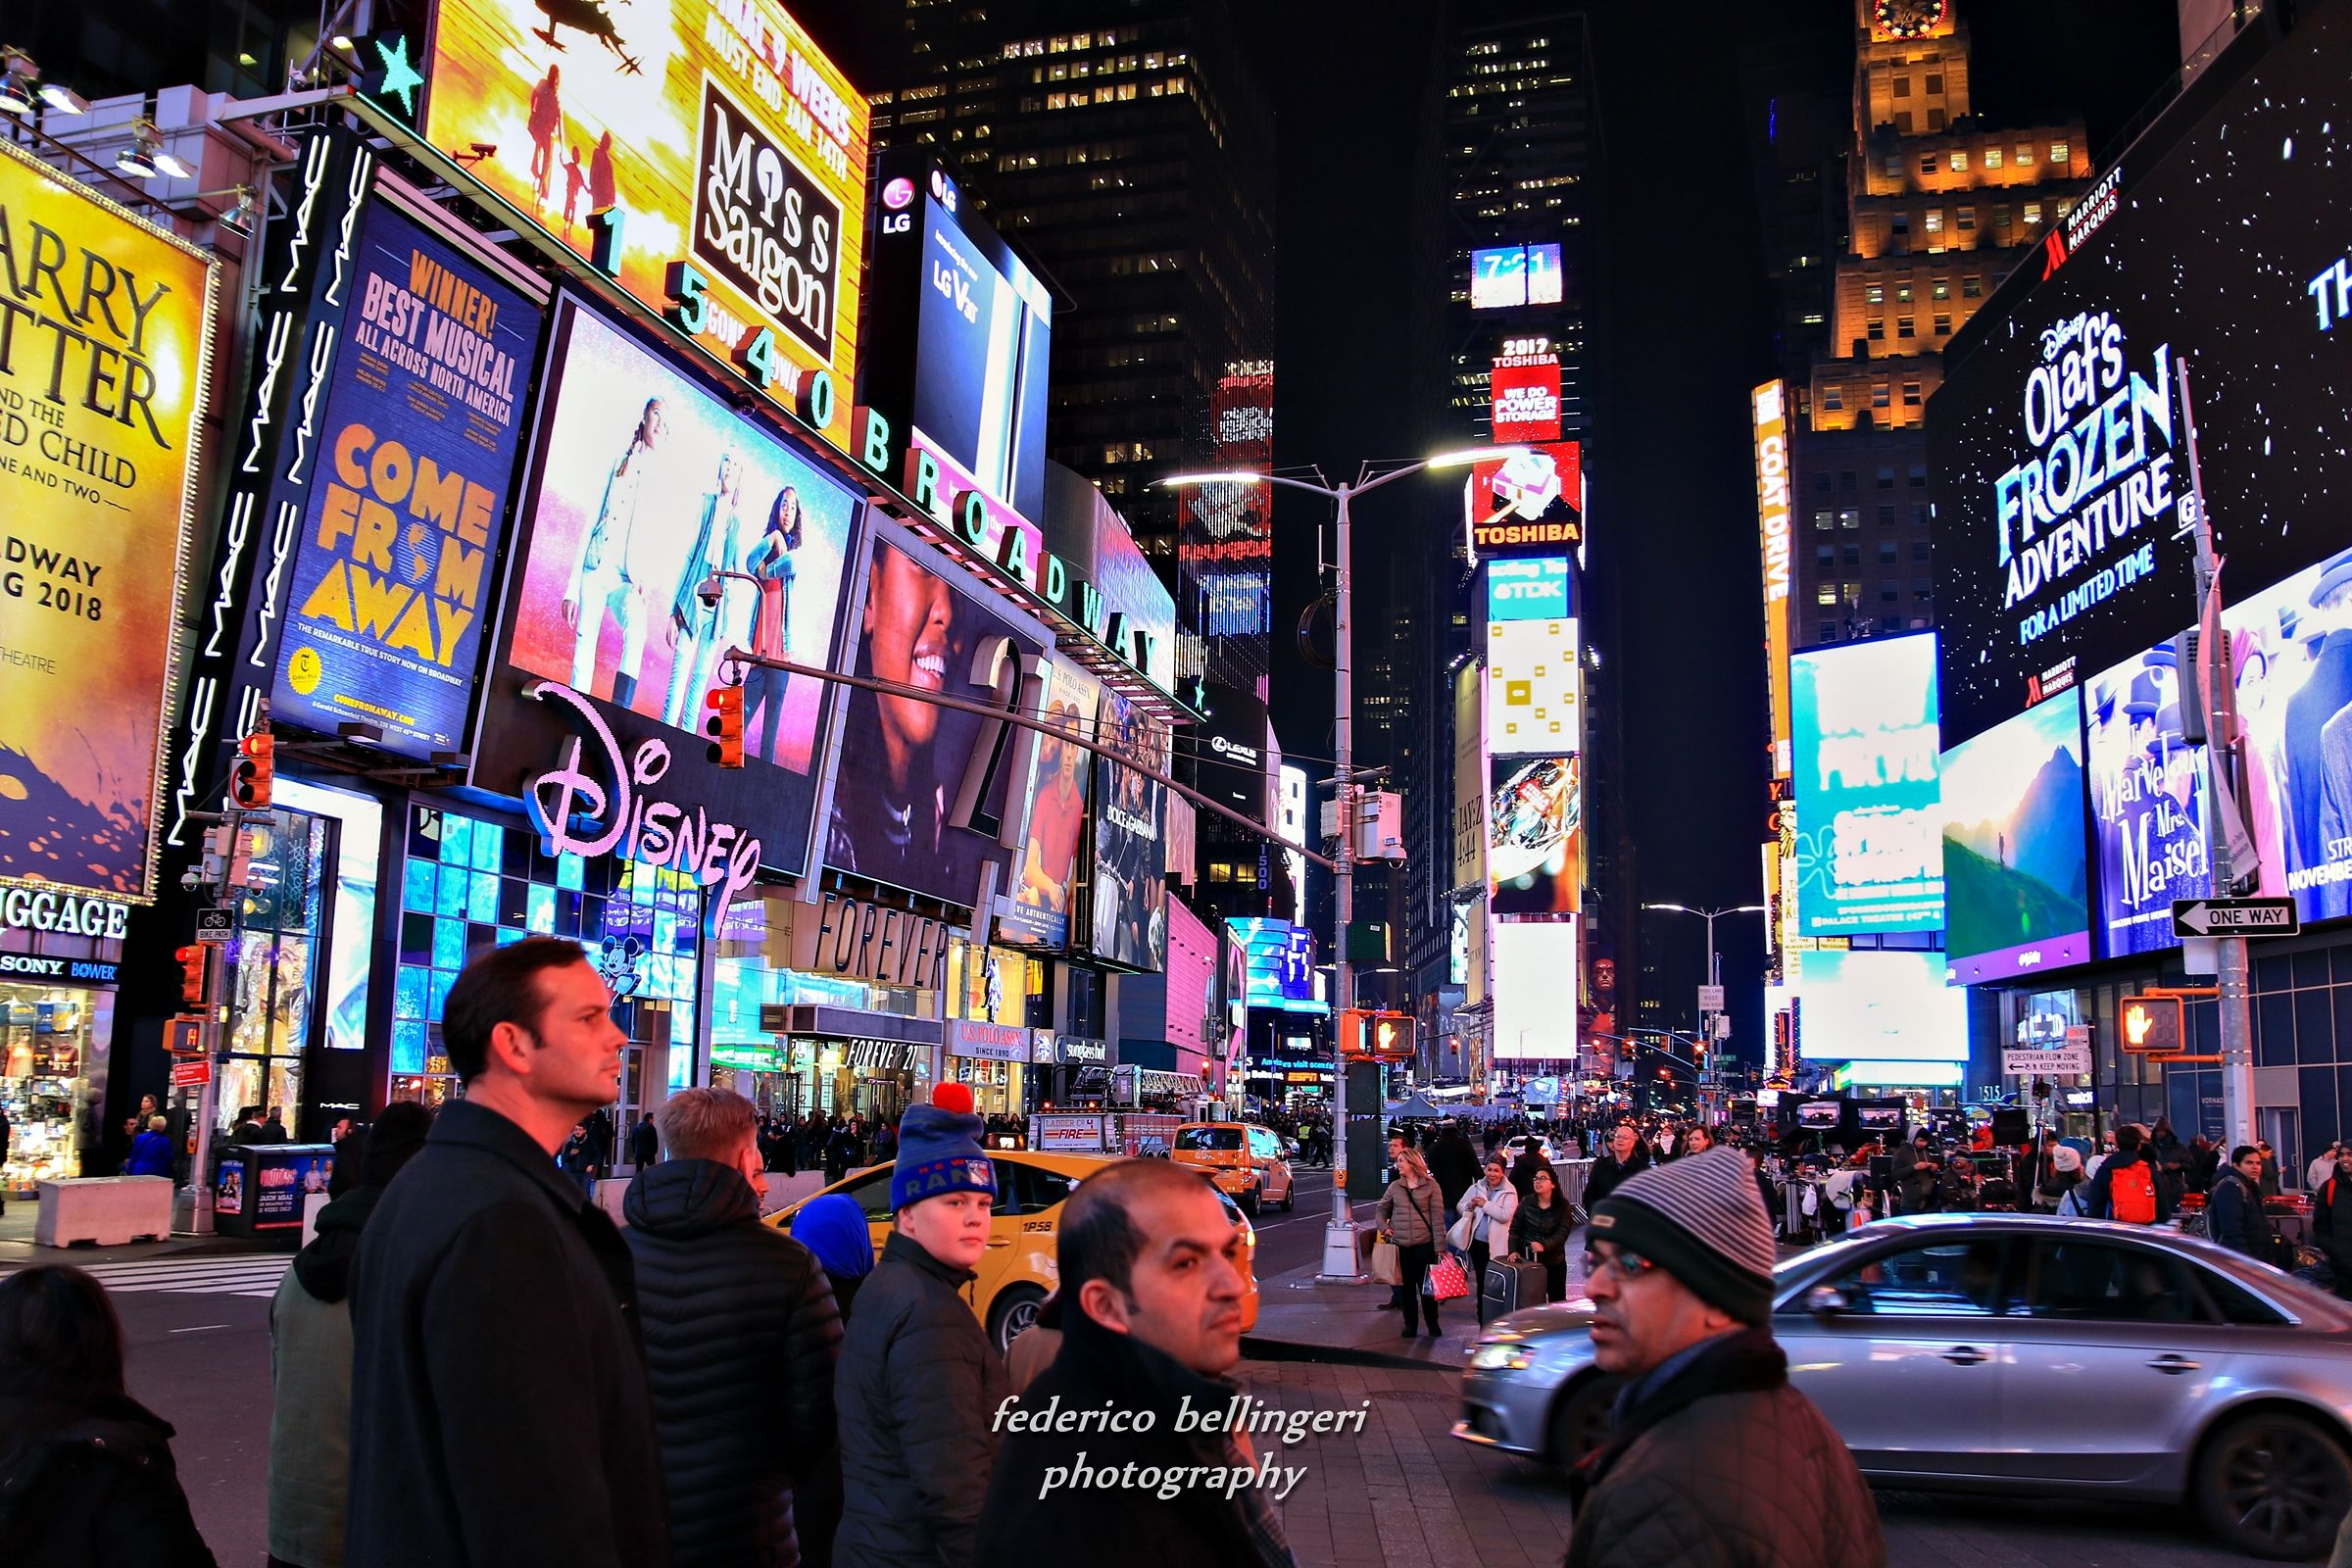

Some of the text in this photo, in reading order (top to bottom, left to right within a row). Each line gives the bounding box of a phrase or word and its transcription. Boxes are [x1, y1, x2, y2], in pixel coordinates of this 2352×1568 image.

[705, 11, 848, 183] MUST END JAN 14TH
[772, 31, 851, 147] 9 WEEKS
[942, 182, 956, 213] LG
[2068, 167, 2123, 230] MARRIOTT
[883, 214, 911, 234] LG
[2069, 193, 2118, 251] MARQUIS
[704, 174, 828, 342] Saigon
[410, 249, 498, 340] WINNER!
[934, 260, 952, 299] LG
[362, 271, 514, 403] BEST MUSICAL
[1503, 338, 1548, 356] 2017
[355, 320, 379, 353] ALL
[380, 335, 429, 379] ACROSS
[429, 362, 466, 401] NORTH
[466, 384, 512, 427] AMERICA
[1493, 354, 1558, 368] TOSHIBA
[1504, 385, 1547, 398] WE DO
[2025, 312, 2123, 447] Olaf's
[29, 399, 64, 428] THE
[1494, 398, 1557, 413] POWER
[1494, 410, 1557, 424] STORAGE
[0, 410, 136, 489] D CHILD
[1994, 342, 2173, 567] FROZEN
[22, 465, 57, 488] AND
[63, 478, 101, 504] TWO
[334, 423, 496, 549] COME
[1760, 436, 1788, 509] COAT
[2181, 495, 2197, 522] G
[1474, 522, 1580, 546] TOSHIBA
[2004, 452, 2173, 610] ADVENTURE
[0, 536, 102, 587] DWAY
[1764, 513, 1789, 602] DRIVE
[37, 582, 102, 621] 2018
[1510, 580, 1563, 599] TDK
[2020, 542, 2154, 646] FOR A LIMITED TIME
[299, 558, 474, 668] AWAY
[297, 621, 463, 687] THE REMARKABLE TRUE STORY NOW ON BROADWAY
[2041, 656, 2076, 681] MARRIOTT
[2042, 672, 2073, 696] MARQUIS
[333, 694, 416, 727] COMEFROMAWAY.COM
[1227, 742, 1256, 759] LEXUS
[2118, 790, 2210, 910] Maisel
[1258, 844, 1267, 891] 1500
[1026, 907, 1065, 926] AUTHENTICALLY
[2210, 908, 2283, 925] ONE WAY
[813, 890, 950, 991] FOREVER
[0, 956, 116, 980] SONY BOWER
[960, 1022, 975, 1042] U.S.
[978, 1024, 999, 1045] POLO
[846, 1039, 918, 1071] FOREVER 21
[975, 1047, 1009, 1057] SINCE 1890
[1066, 1041, 1105, 1063] sunglass hut
[2007, 1053, 2079, 1061] PEDESTRIAN FLOW ZONE
[1980, 1086, 2000, 1101] 1515
[1058, 1129, 1084, 1140] FIRE
[1023, 1221, 1053, 1233] 1P58
